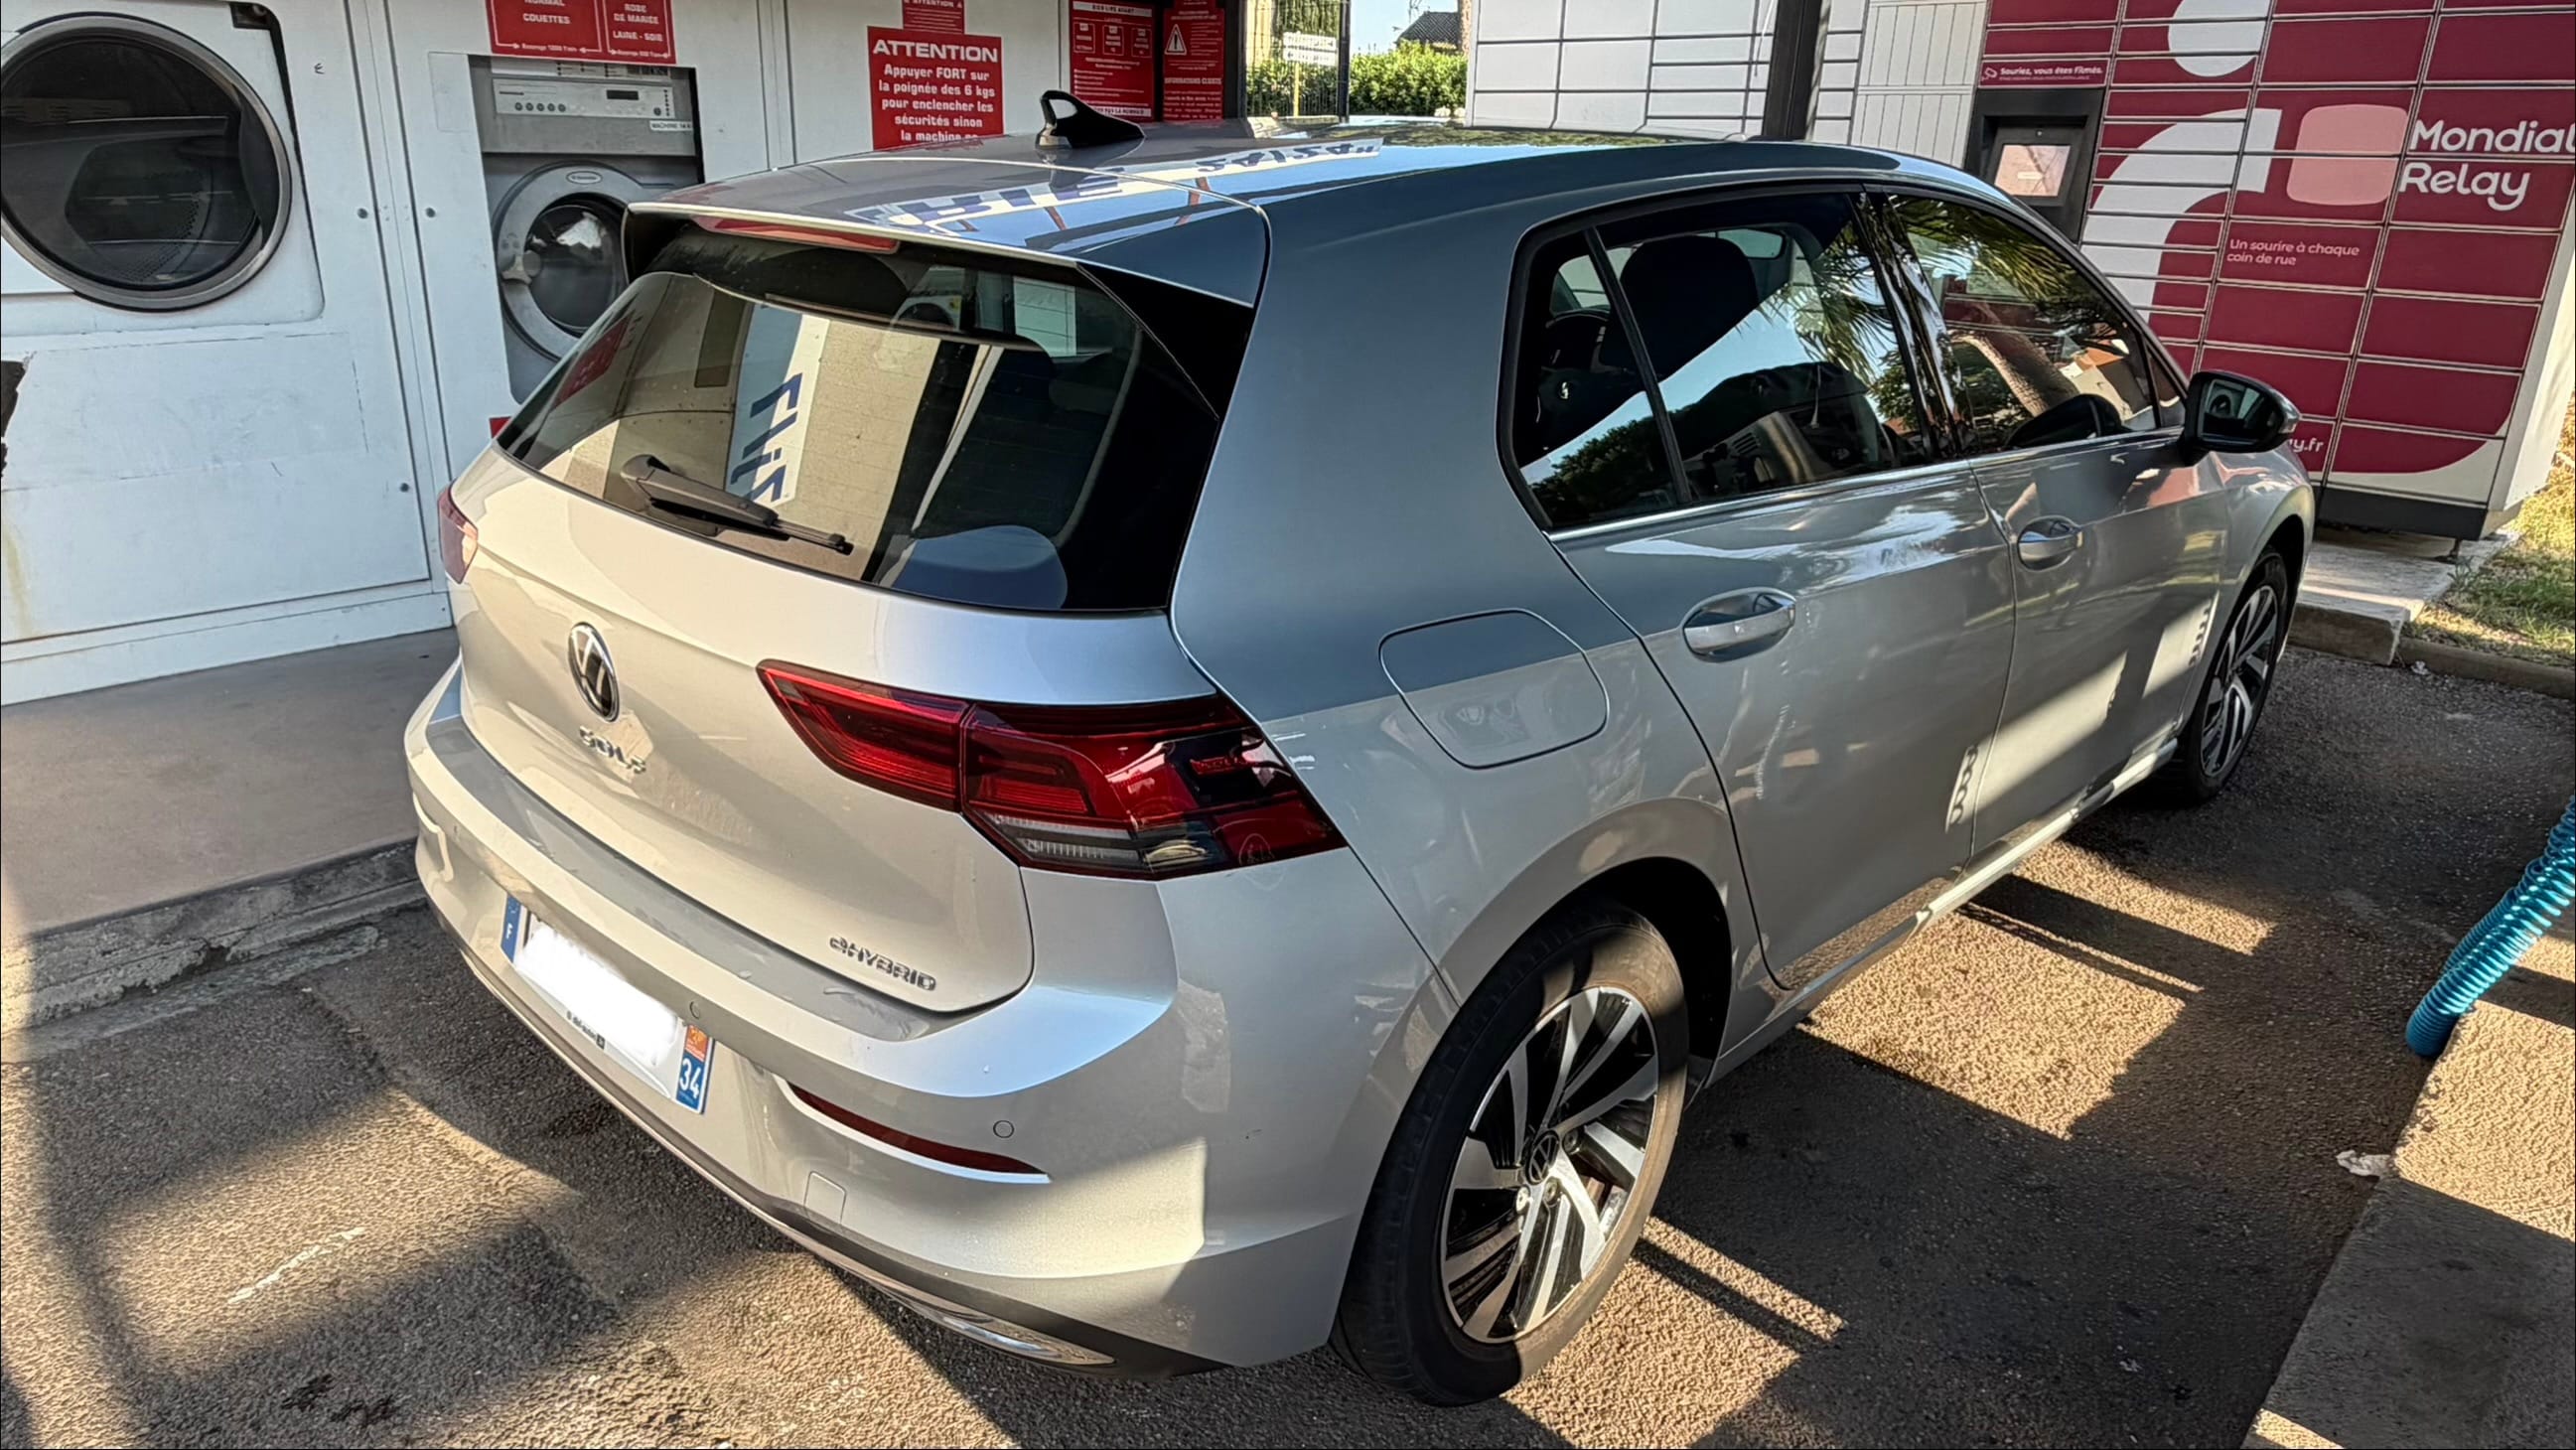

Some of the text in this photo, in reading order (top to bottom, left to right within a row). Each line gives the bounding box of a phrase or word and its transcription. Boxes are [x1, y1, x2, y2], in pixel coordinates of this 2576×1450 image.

[522, 12, 571, 24] COUETTES
[873, 39, 998, 63] ATTENTION
[884, 63, 990, 81] Appuyer FORT sur
[879, 78, 996, 99] la poignée des 6 kgs
[881, 98, 994, 113] pour enclencher les
[895, 112, 983, 128] sécurités sinon
[901, 129, 962, 143] la machine
[2408, 119, 2575, 154] Mondial
[2399, 161, 2531, 212] Relay
[2229, 238, 2361, 257] Un sourire à chaque
[2226, 251, 2297, 267] coin de rue
[505, 924, 513, 940] F
[679, 1058, 701, 1099] 34
